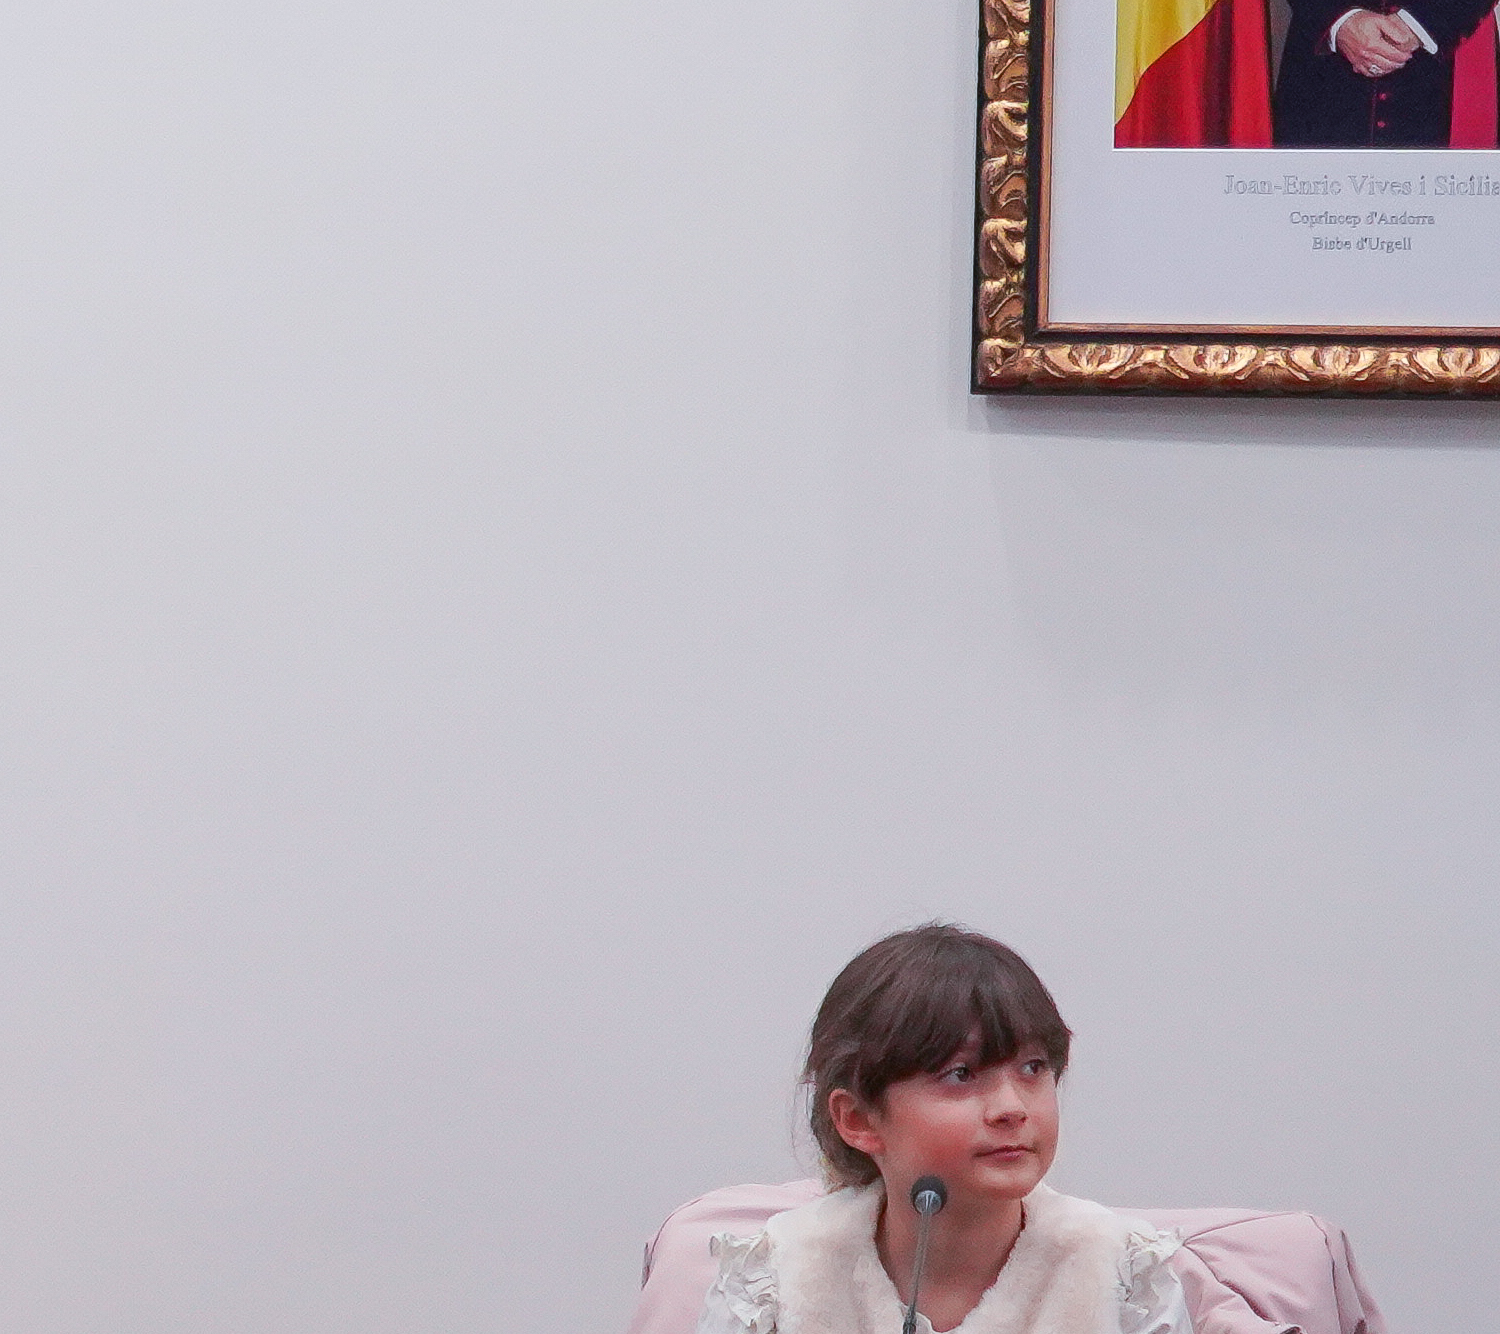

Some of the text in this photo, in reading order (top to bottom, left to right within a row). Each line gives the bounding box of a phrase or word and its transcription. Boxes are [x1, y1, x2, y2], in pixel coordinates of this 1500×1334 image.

[1223, 174, 1342, 196] Joan-Enric
[1349, 174, 1413, 196] Vives
[1419, 175, 1427, 196] i
[1312, 236, 1412, 254] Bisbe d'Urgell
